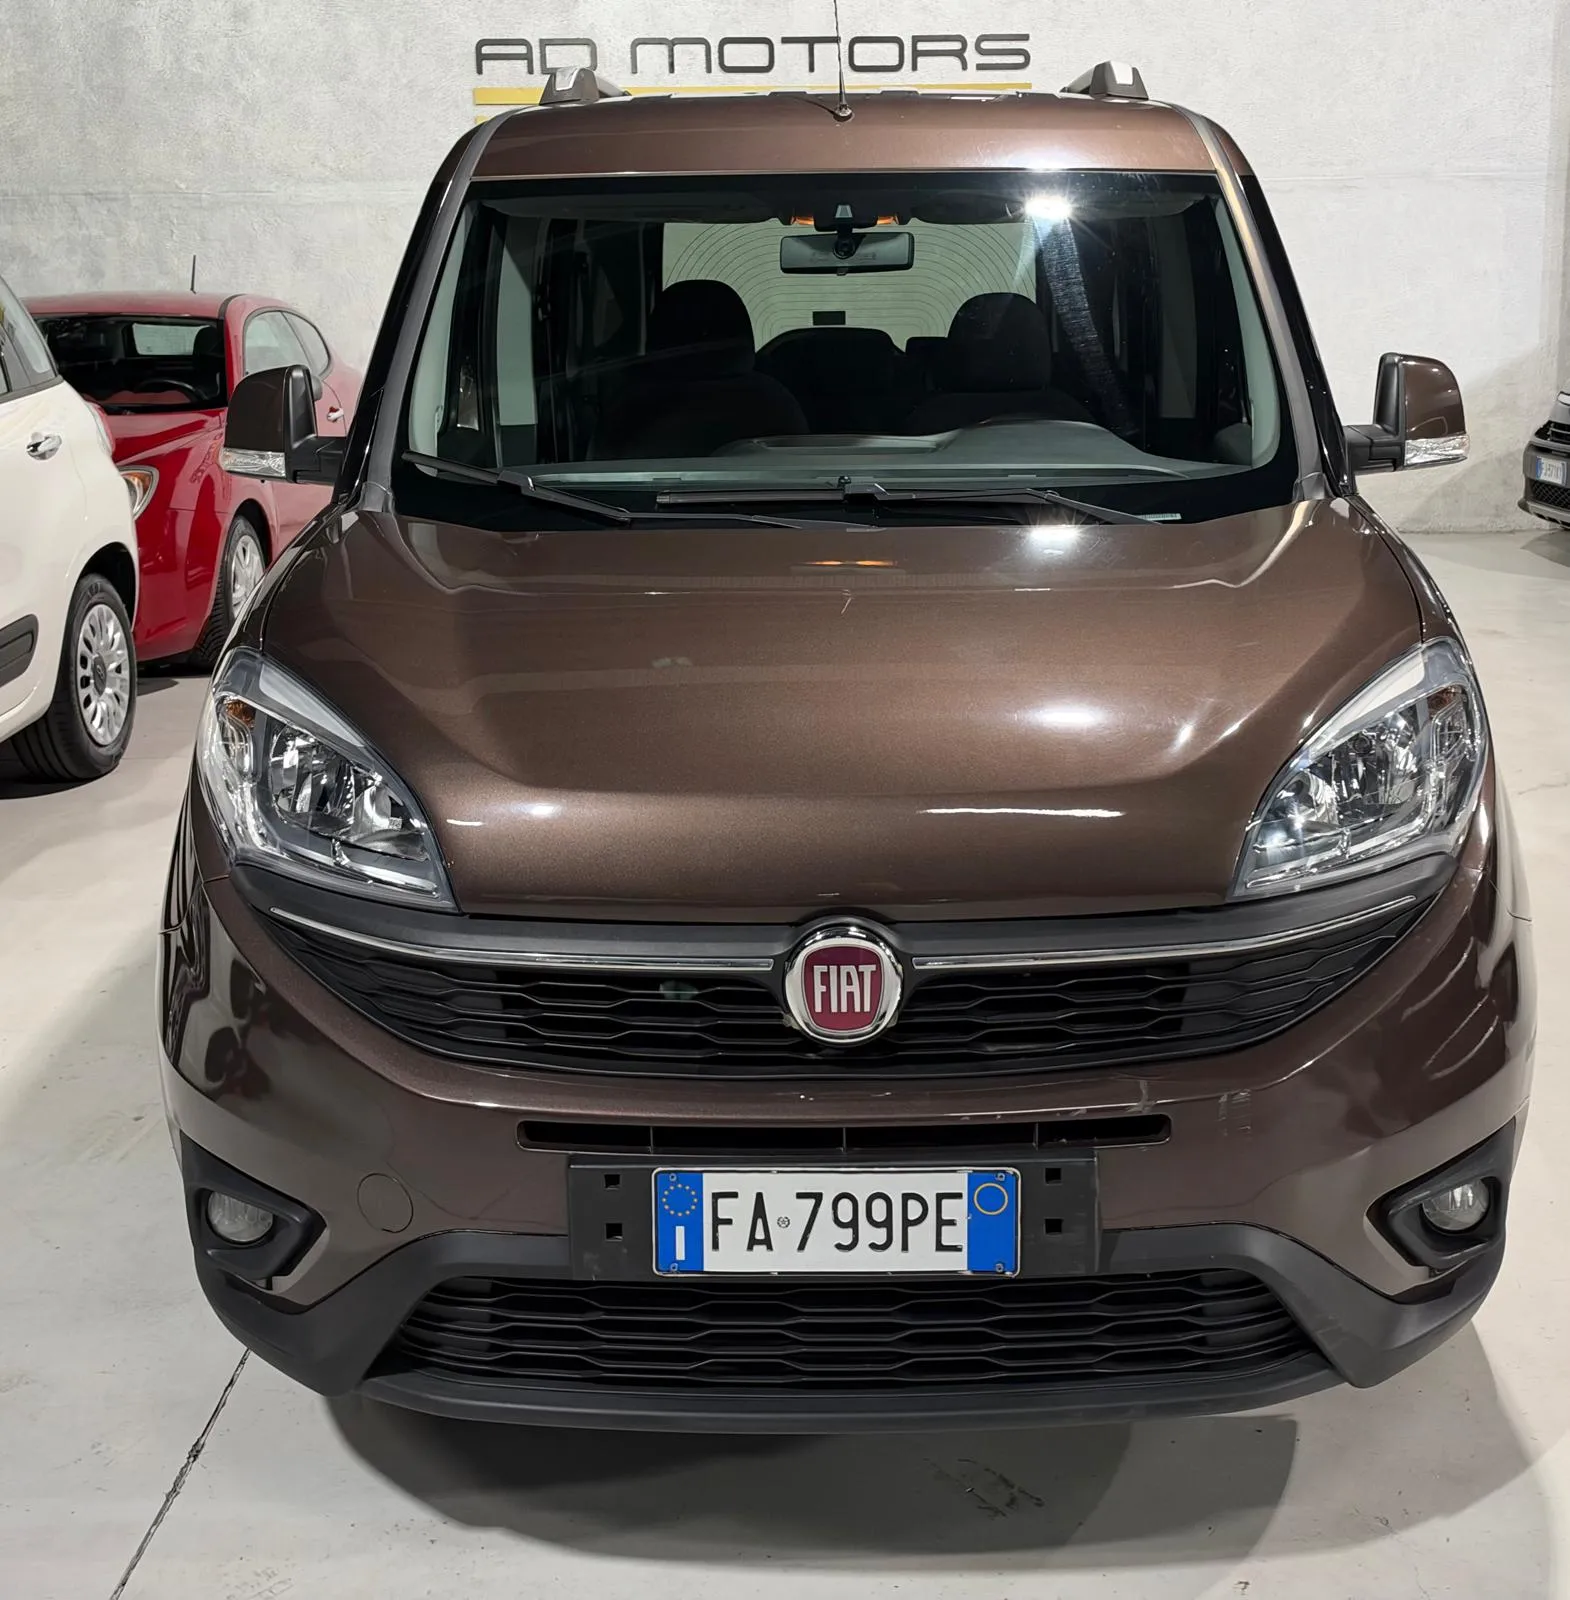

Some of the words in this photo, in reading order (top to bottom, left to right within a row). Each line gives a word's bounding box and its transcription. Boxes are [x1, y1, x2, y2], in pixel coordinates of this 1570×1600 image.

[476, 38, 597, 75] AD
[631, 33, 1031, 74] MOTORS
[813, 964, 877, 1013] FIAT
[675, 1225, 686, 1261] I
